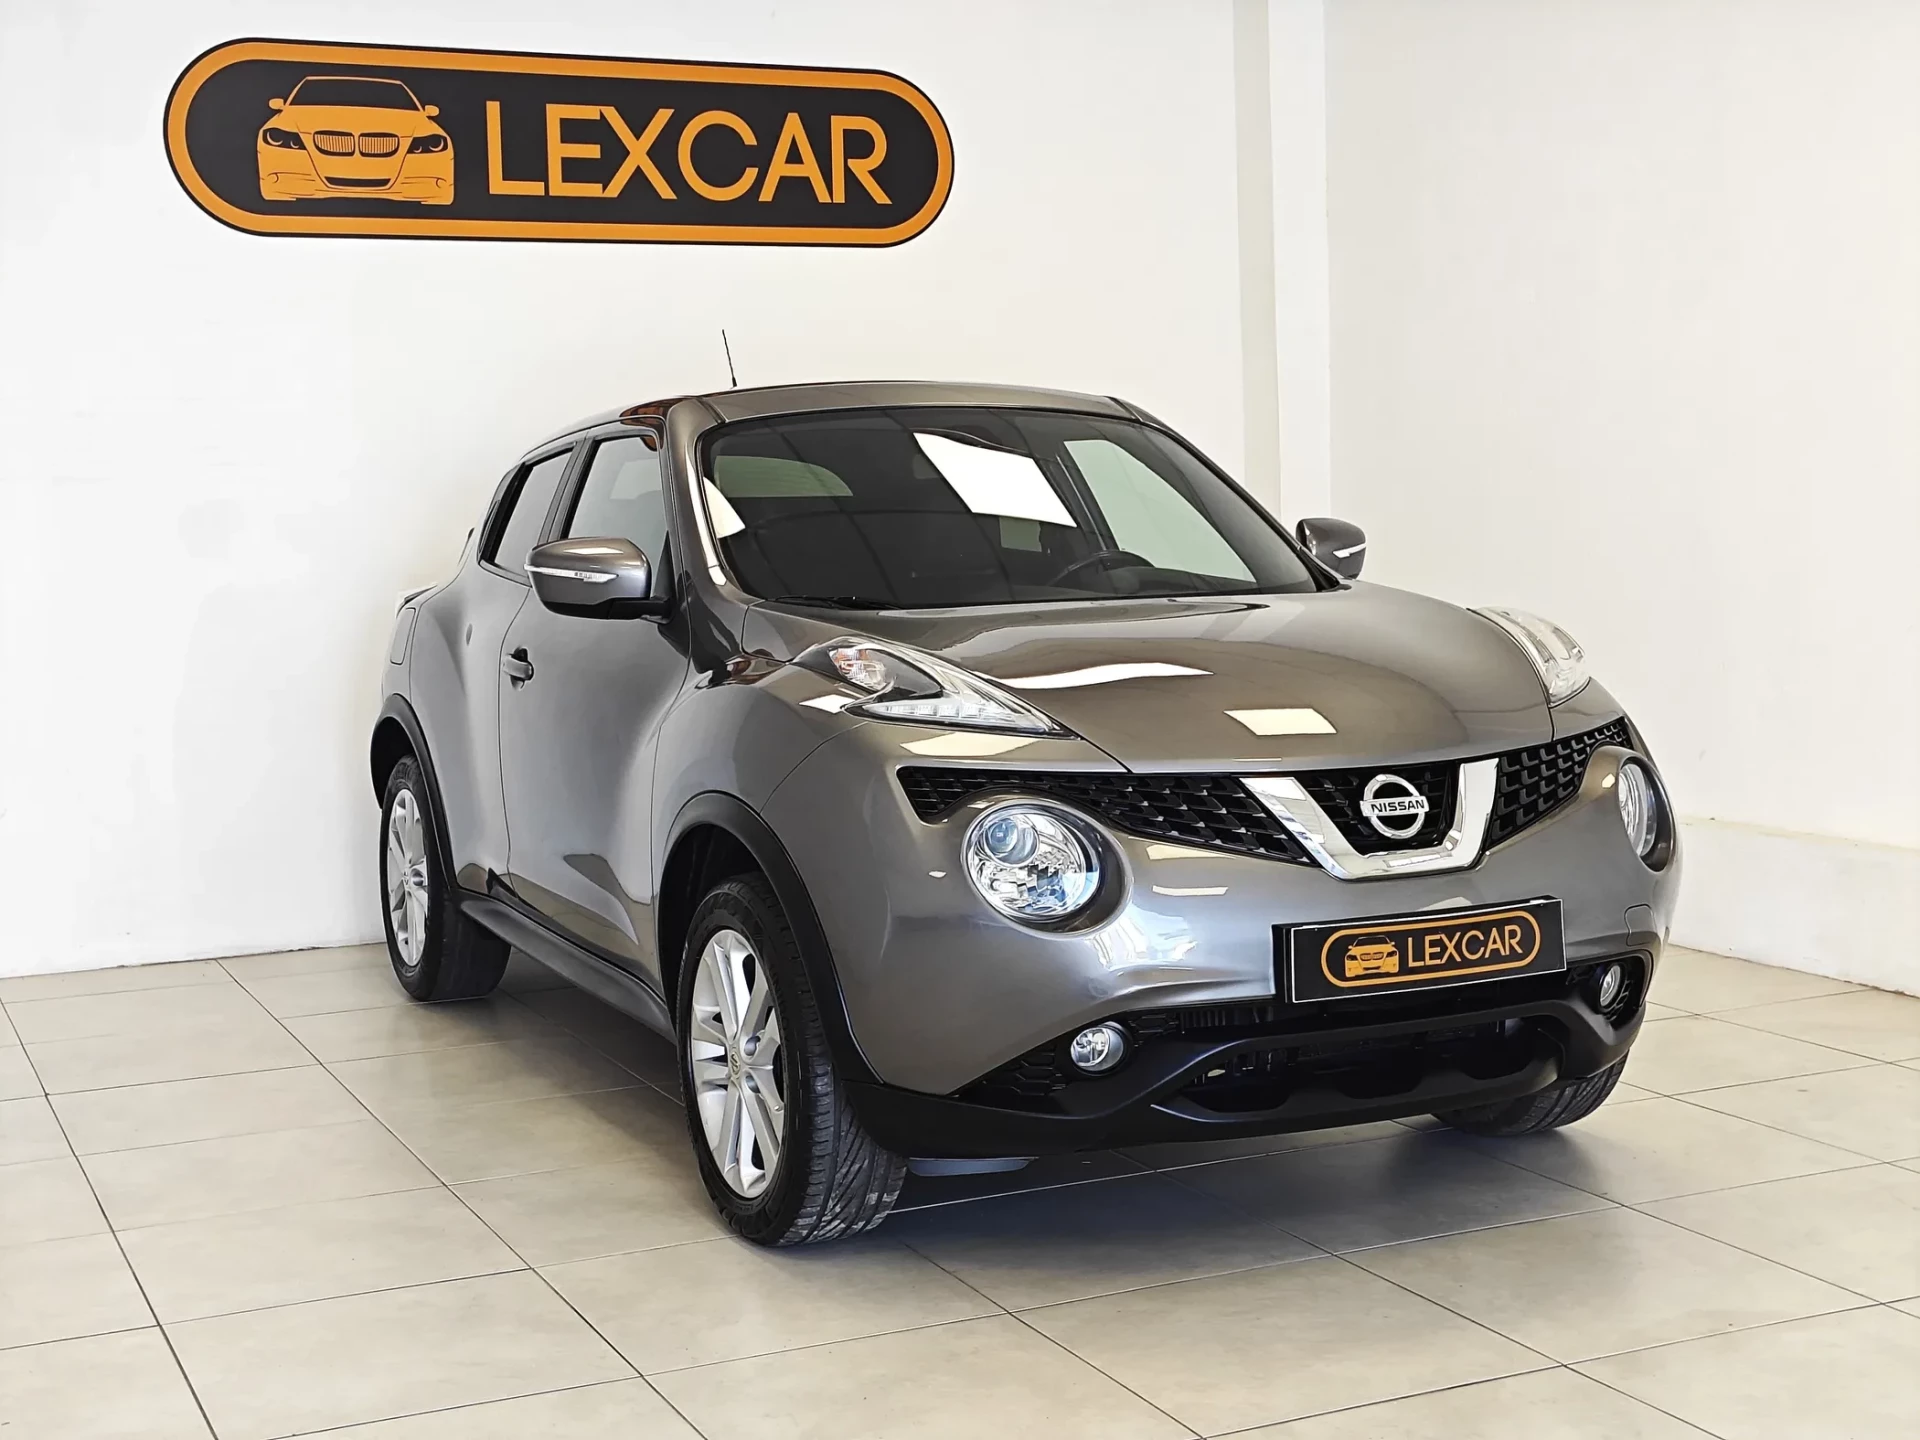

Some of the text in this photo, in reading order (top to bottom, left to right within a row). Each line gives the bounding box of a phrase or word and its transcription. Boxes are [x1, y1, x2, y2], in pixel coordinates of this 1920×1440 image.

[485, 100, 893, 205] LEXCAR
[1370, 799, 1425, 813] NISSAN
[1407, 924, 1524, 968] LEXCAR
